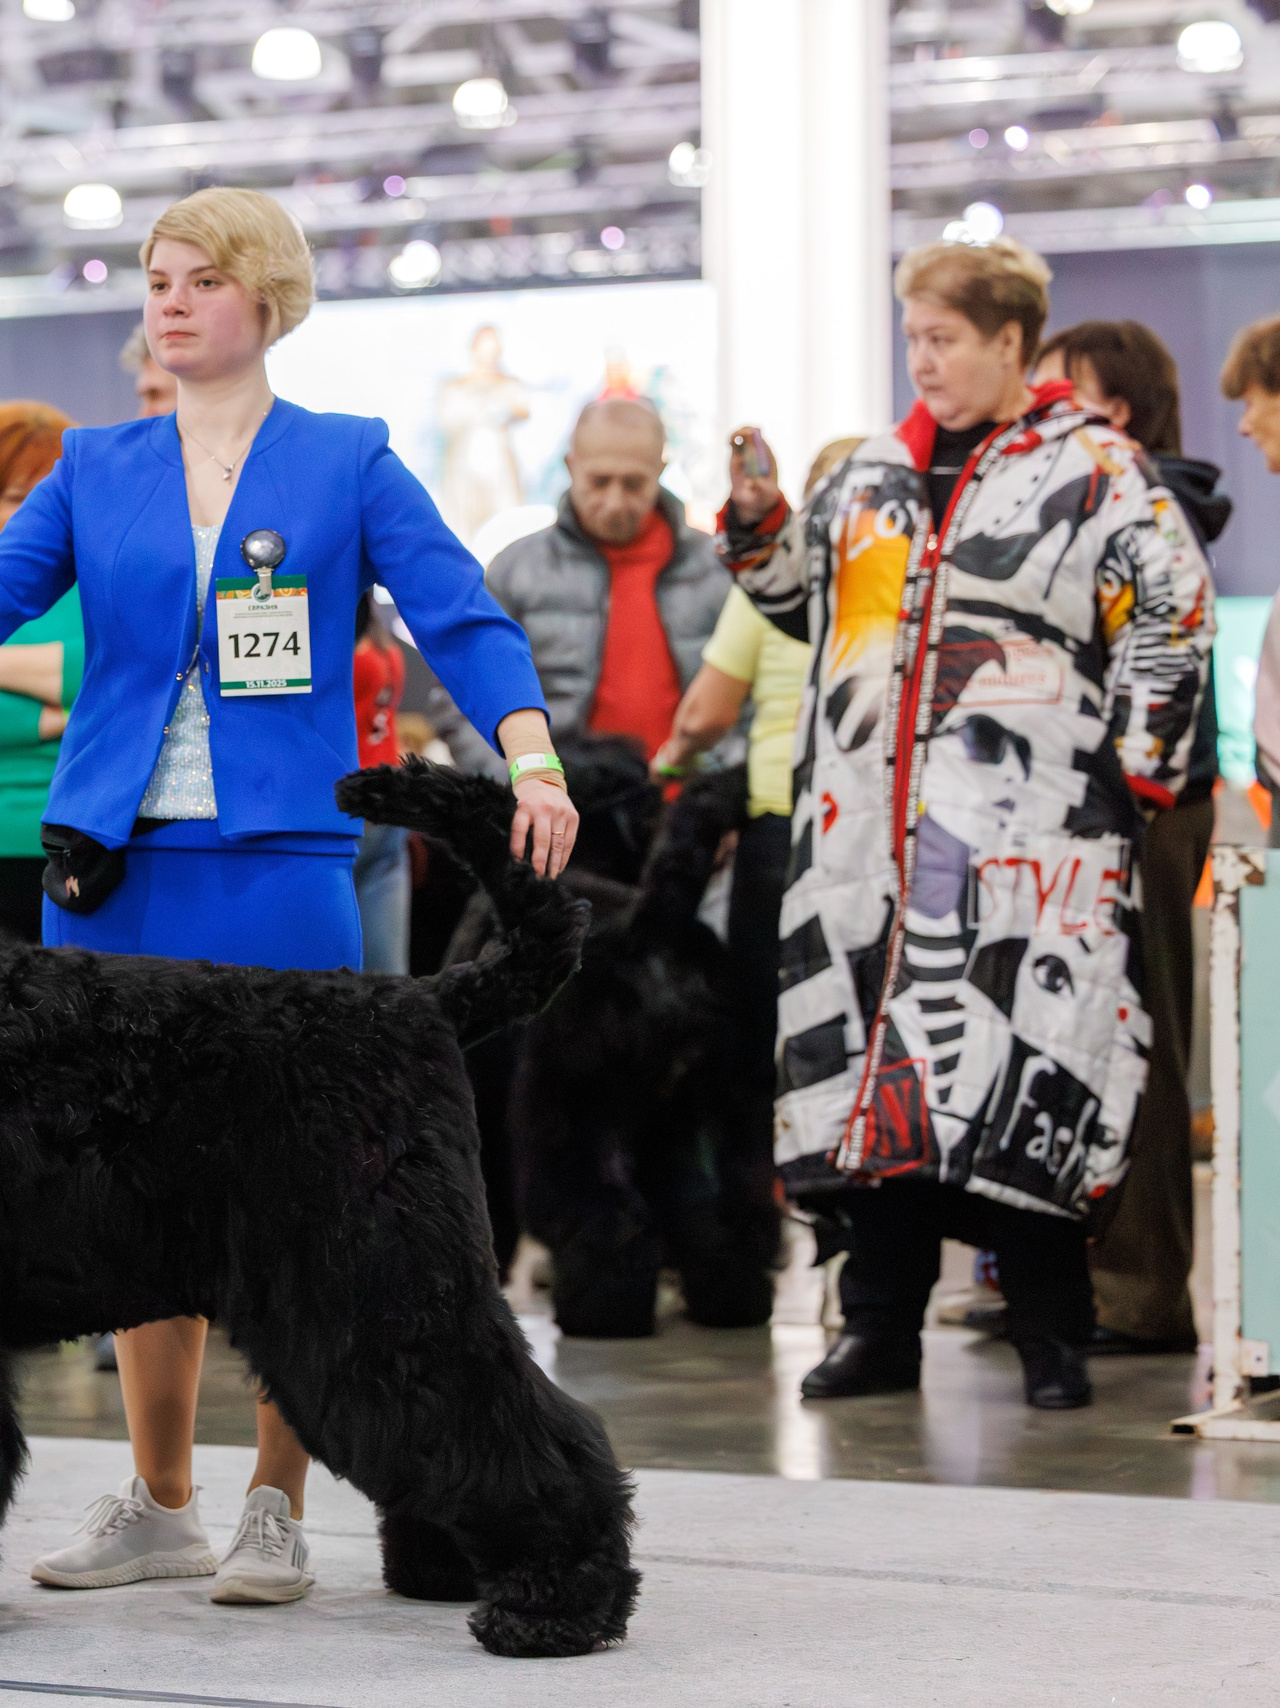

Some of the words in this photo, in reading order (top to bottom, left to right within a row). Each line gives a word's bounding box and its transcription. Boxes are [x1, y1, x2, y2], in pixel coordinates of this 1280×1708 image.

[228, 631, 301, 659] 1274
[245, 679, 288, 689] 15.11.2025
[977, 856, 1129, 937] STYLE
